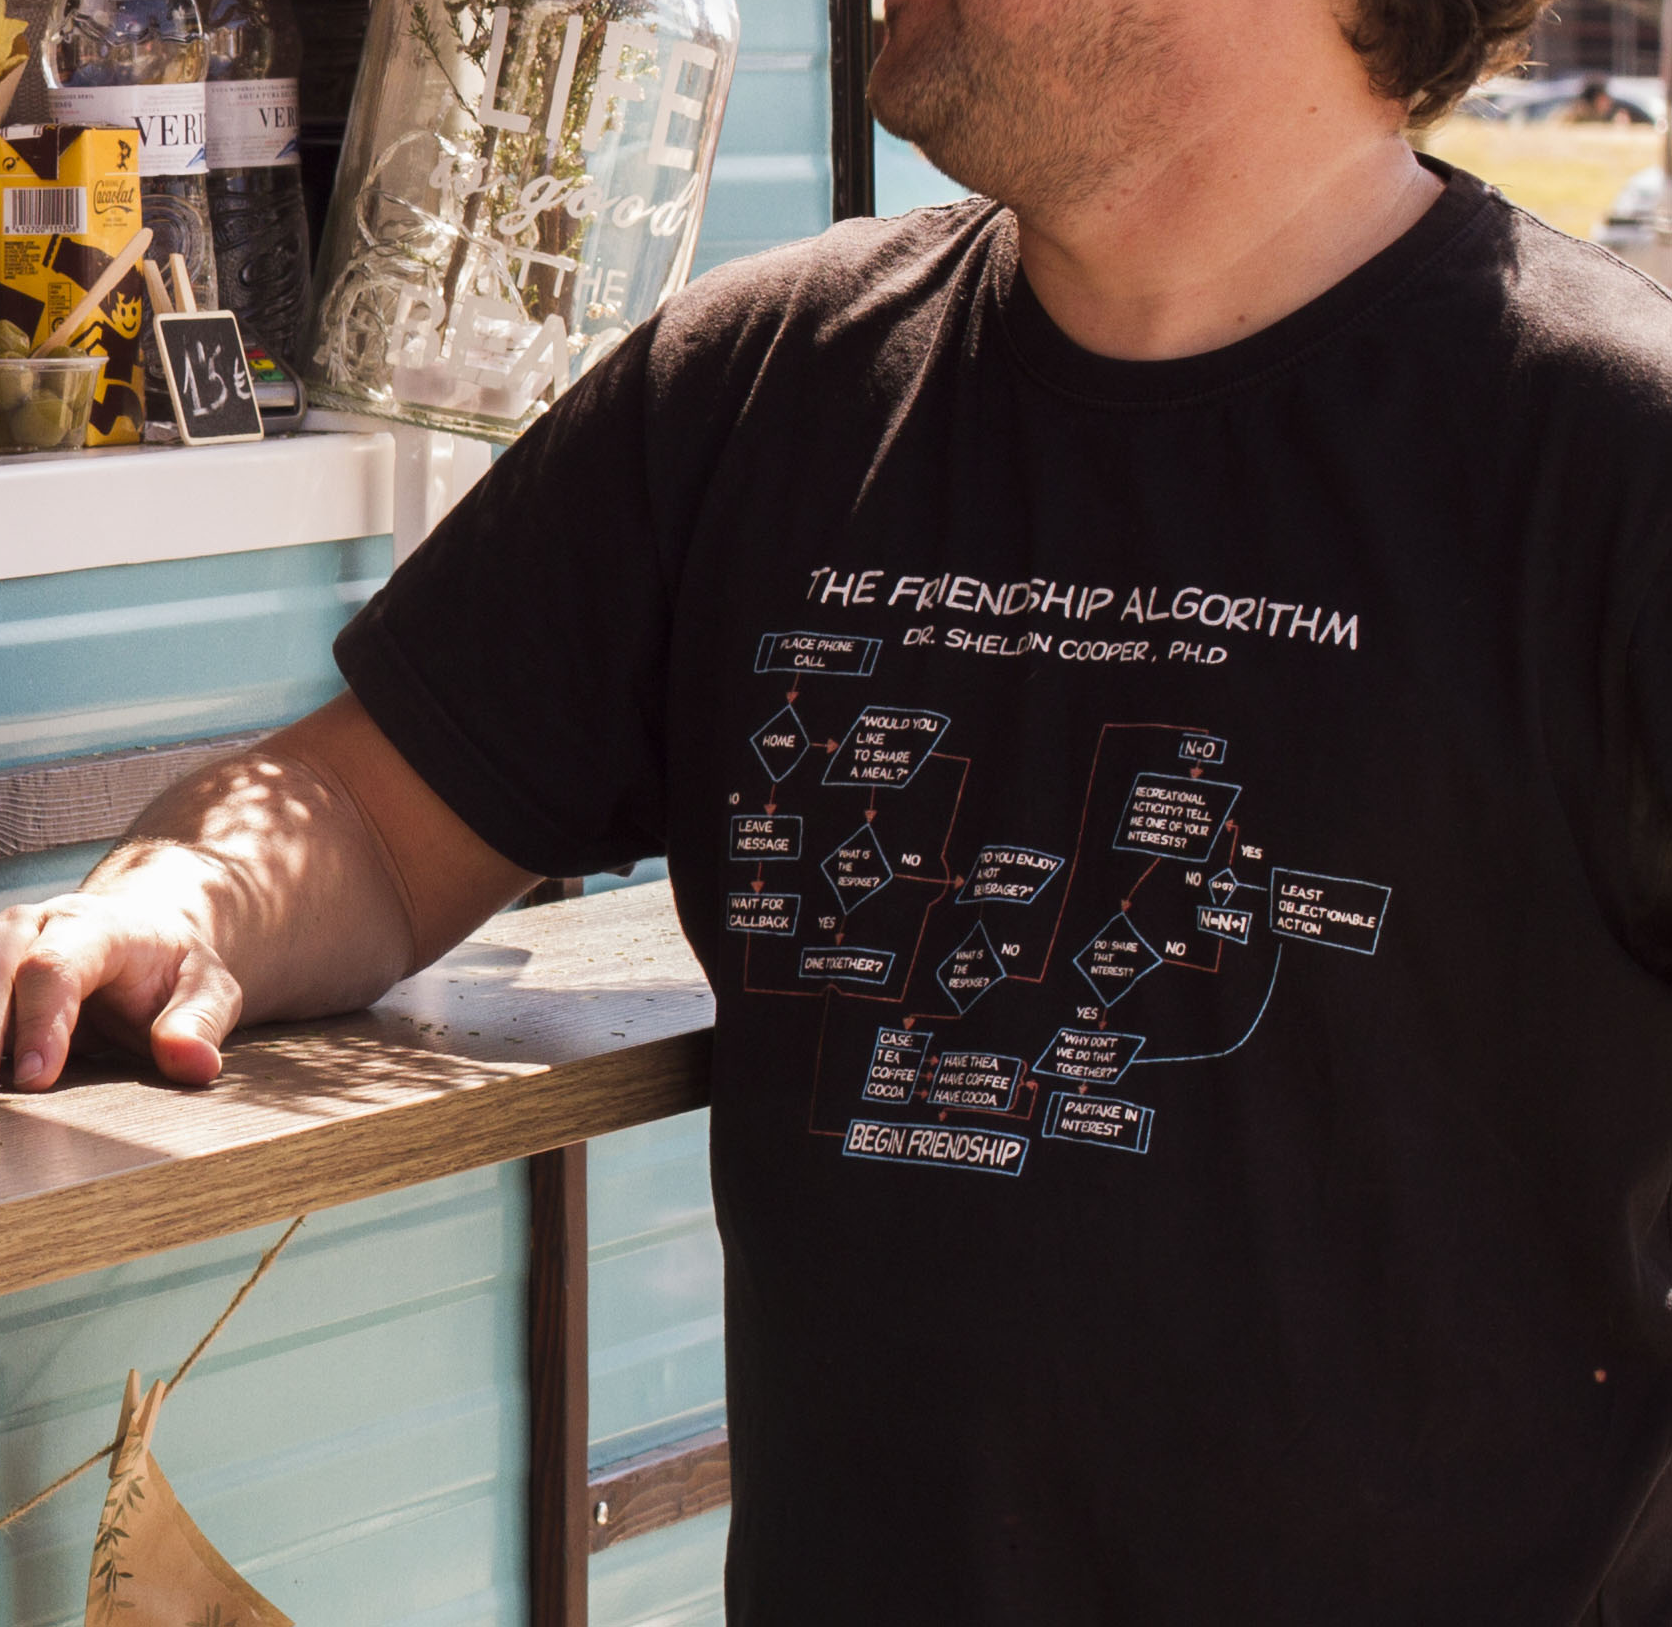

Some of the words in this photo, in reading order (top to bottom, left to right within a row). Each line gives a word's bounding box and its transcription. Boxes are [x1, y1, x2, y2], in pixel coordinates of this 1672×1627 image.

[477, 6, 716, 170] LIFE
[807, 567, 884, 607] THE
[887, 573, 1114, 621] FRIENDSHIP
[1121, 586, 1358, 650] ALGORITHM
[817, 640, 855, 652] PHONE
[903, 625, 935, 646] DR.
[1168, 641, 1228, 664] PH.D
[794, 654, 825, 667] CALL
[912, 718, 938, 732] YOU
[763, 735, 796, 747] HOME
[857, 732, 885, 745] LIKE
[854, 749, 870, 762] TO
[872, 751, 911, 764] SHARE
[849, 768, 859, 778] A
[1135, 787, 1206, 805] RECREATIONAL
[1186, 808, 1213, 822] TELL
[738, 820, 774, 833] LEAVE
[1130, 817, 1144, 827] ME
[1146, 818, 1168, 830] ONE
[1169, 821, 1183, 833] OF
[1184, 823, 1210, 836] YOUR
[737, 838, 790, 851] MESSAGE
[1127, 831, 1188, 848] INTERESTS?
[838, 849, 860, 859] WHAT
[861, 850, 872, 860] IS
[1241, 844, 1263, 859] YES
[838, 862, 853, 872] THE
[901, 853, 922, 867] NO
[994, 852, 1015, 864] YOU
[1016, 853, 1058, 871] ENJOY
[1185, 872, 1202, 887] NO
[1281, 884, 1324, 902] LEAST
[731, 898, 760, 909] WAIT
[761, 898, 784, 910] FOR
[729, 915, 790, 929] CALLBACK
[818, 916, 836, 928] YES
[1278, 900, 1377, 929] OBJECTIONABLE
[1277, 917, 1322, 935] ACTION
[1001, 943, 1020, 956] NO
[1094, 940, 1107, 950] DO
[1165, 941, 1186, 956] NO
[1093, 952, 1115, 963] THAT
[953, 964, 969, 974] THE
[1090, 965, 1134, 978] INTEREST?
[1076, 1006, 1099, 1020] YES
[877, 1049, 900, 1064] TEA
[1056, 1047, 1075, 1059] WE
[1075, 1049, 1090, 1060] DO
[1092, 1051, 1117, 1063] THAT
[943, 1055, 968, 1068] HAVE
[969, 1056, 999, 1071] THEA
[871, 1066, 916, 1081] COFFEE
[938, 1073, 965, 1086] HAVE
[965, 1073, 1011, 1090] COFFEE
[867, 1083, 904, 1098] COCOA
[934, 1089, 960, 1103] HAVE
[961, 1090, 998, 1106] COCOA
[1064, 1101, 1122, 1119] PARTAKE
[1124, 1108, 1139, 1122] IN
[1060, 1118, 1124, 1137] INTEREST
[848, 1123, 906, 1154] BEGIN
[907, 1129, 1021, 1166] FRIENDSHIP
